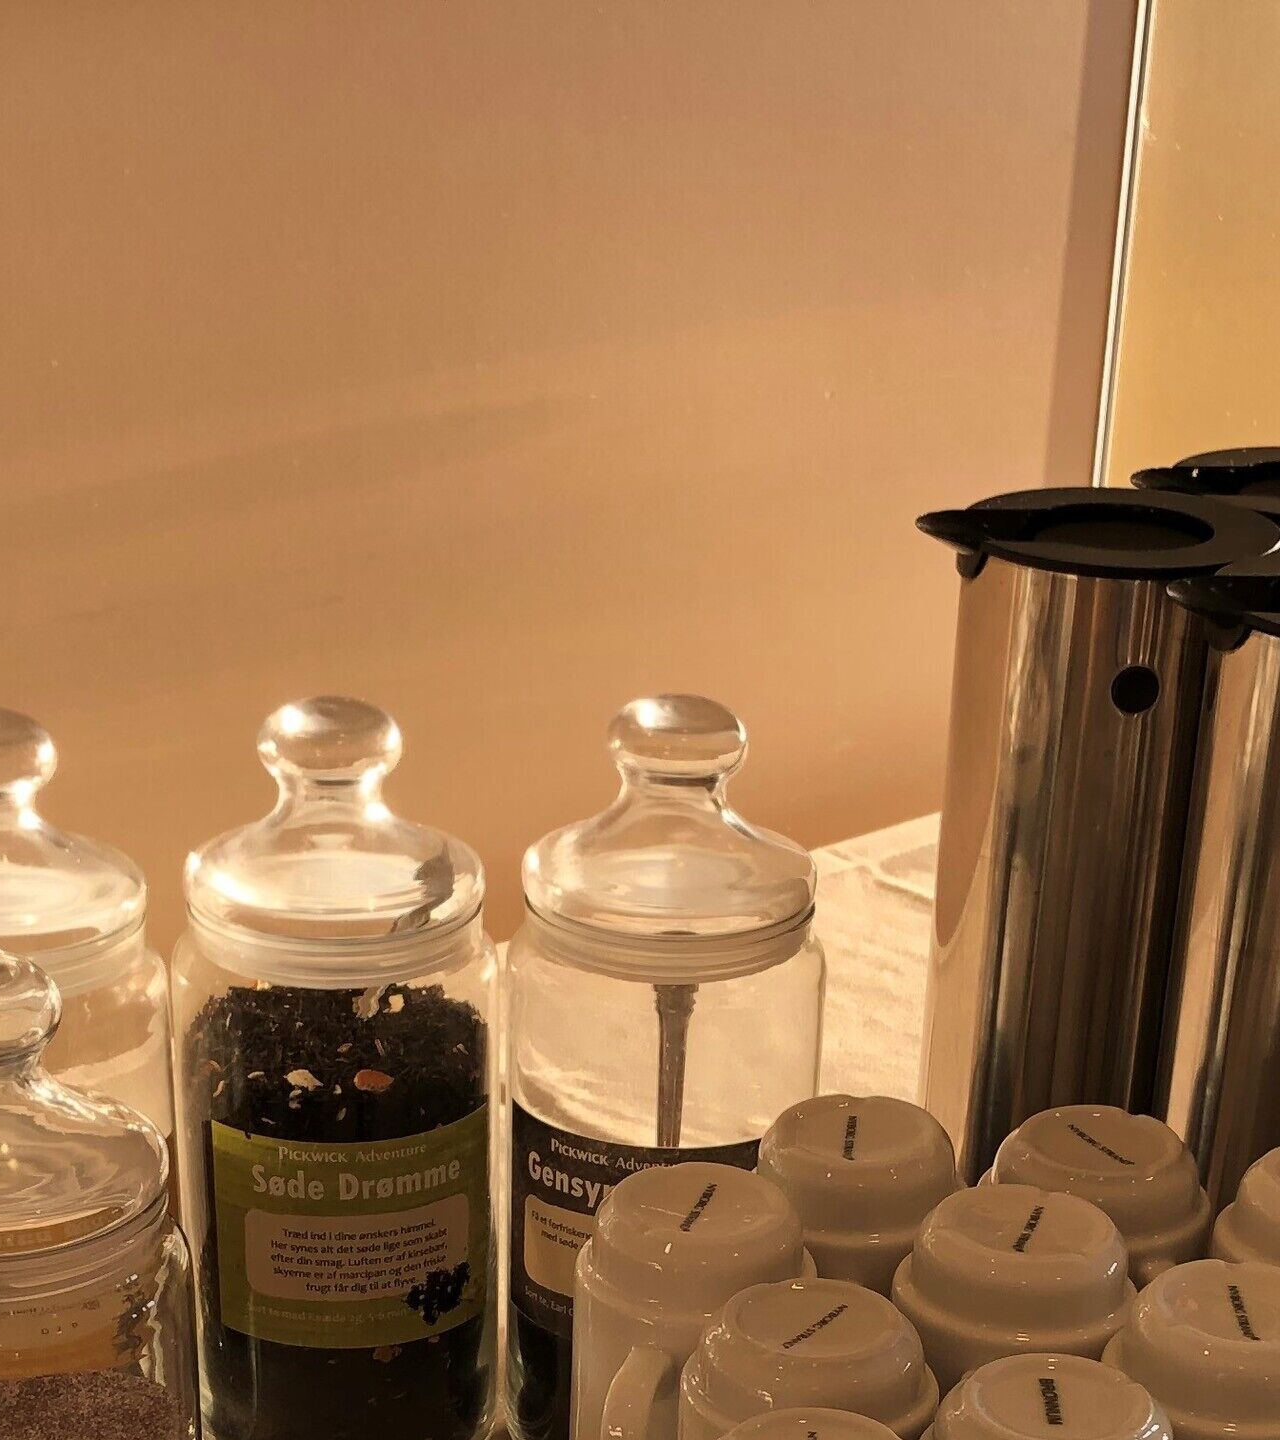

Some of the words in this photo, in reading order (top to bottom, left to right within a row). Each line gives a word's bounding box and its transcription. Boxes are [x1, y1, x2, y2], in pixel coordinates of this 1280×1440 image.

[277, 1144, 349, 1164] PICKWICK
[355, 1142, 428, 1163] Adventure
[550, 1138, 609, 1167] PICKWICK
[251, 1164, 326, 1200] Søde
[338, 1158, 462, 1201] Drømme
[270, 1239, 287, 1250] Her
[402, 1237, 423, 1249] som
[282, 1227, 308, 1240] Træd
[310, 1229, 327, 1240] ind
[334, 1229, 357, 1241] dine
[270, 1253, 295, 1264] efter
[296, 1254, 314, 1266] din
[347, 1253, 382, 1267] Luften
[383, 1254, 394, 1264] er
[395, 1249, 407, 1262] af
[313, 1270, 324, 1280] er
[339, 1268, 387, 1284] marcipan
[388, 1265, 402, 1278] og
[403, 1261, 422, 1274] den
[305, 1281, 332, 1295] frugt
[334, 1280, 349, 1293] får
[351, 1281, 367, 1295] dig
[369, 1279, 379, 1290] til
[381, 1280, 392, 1290] at
